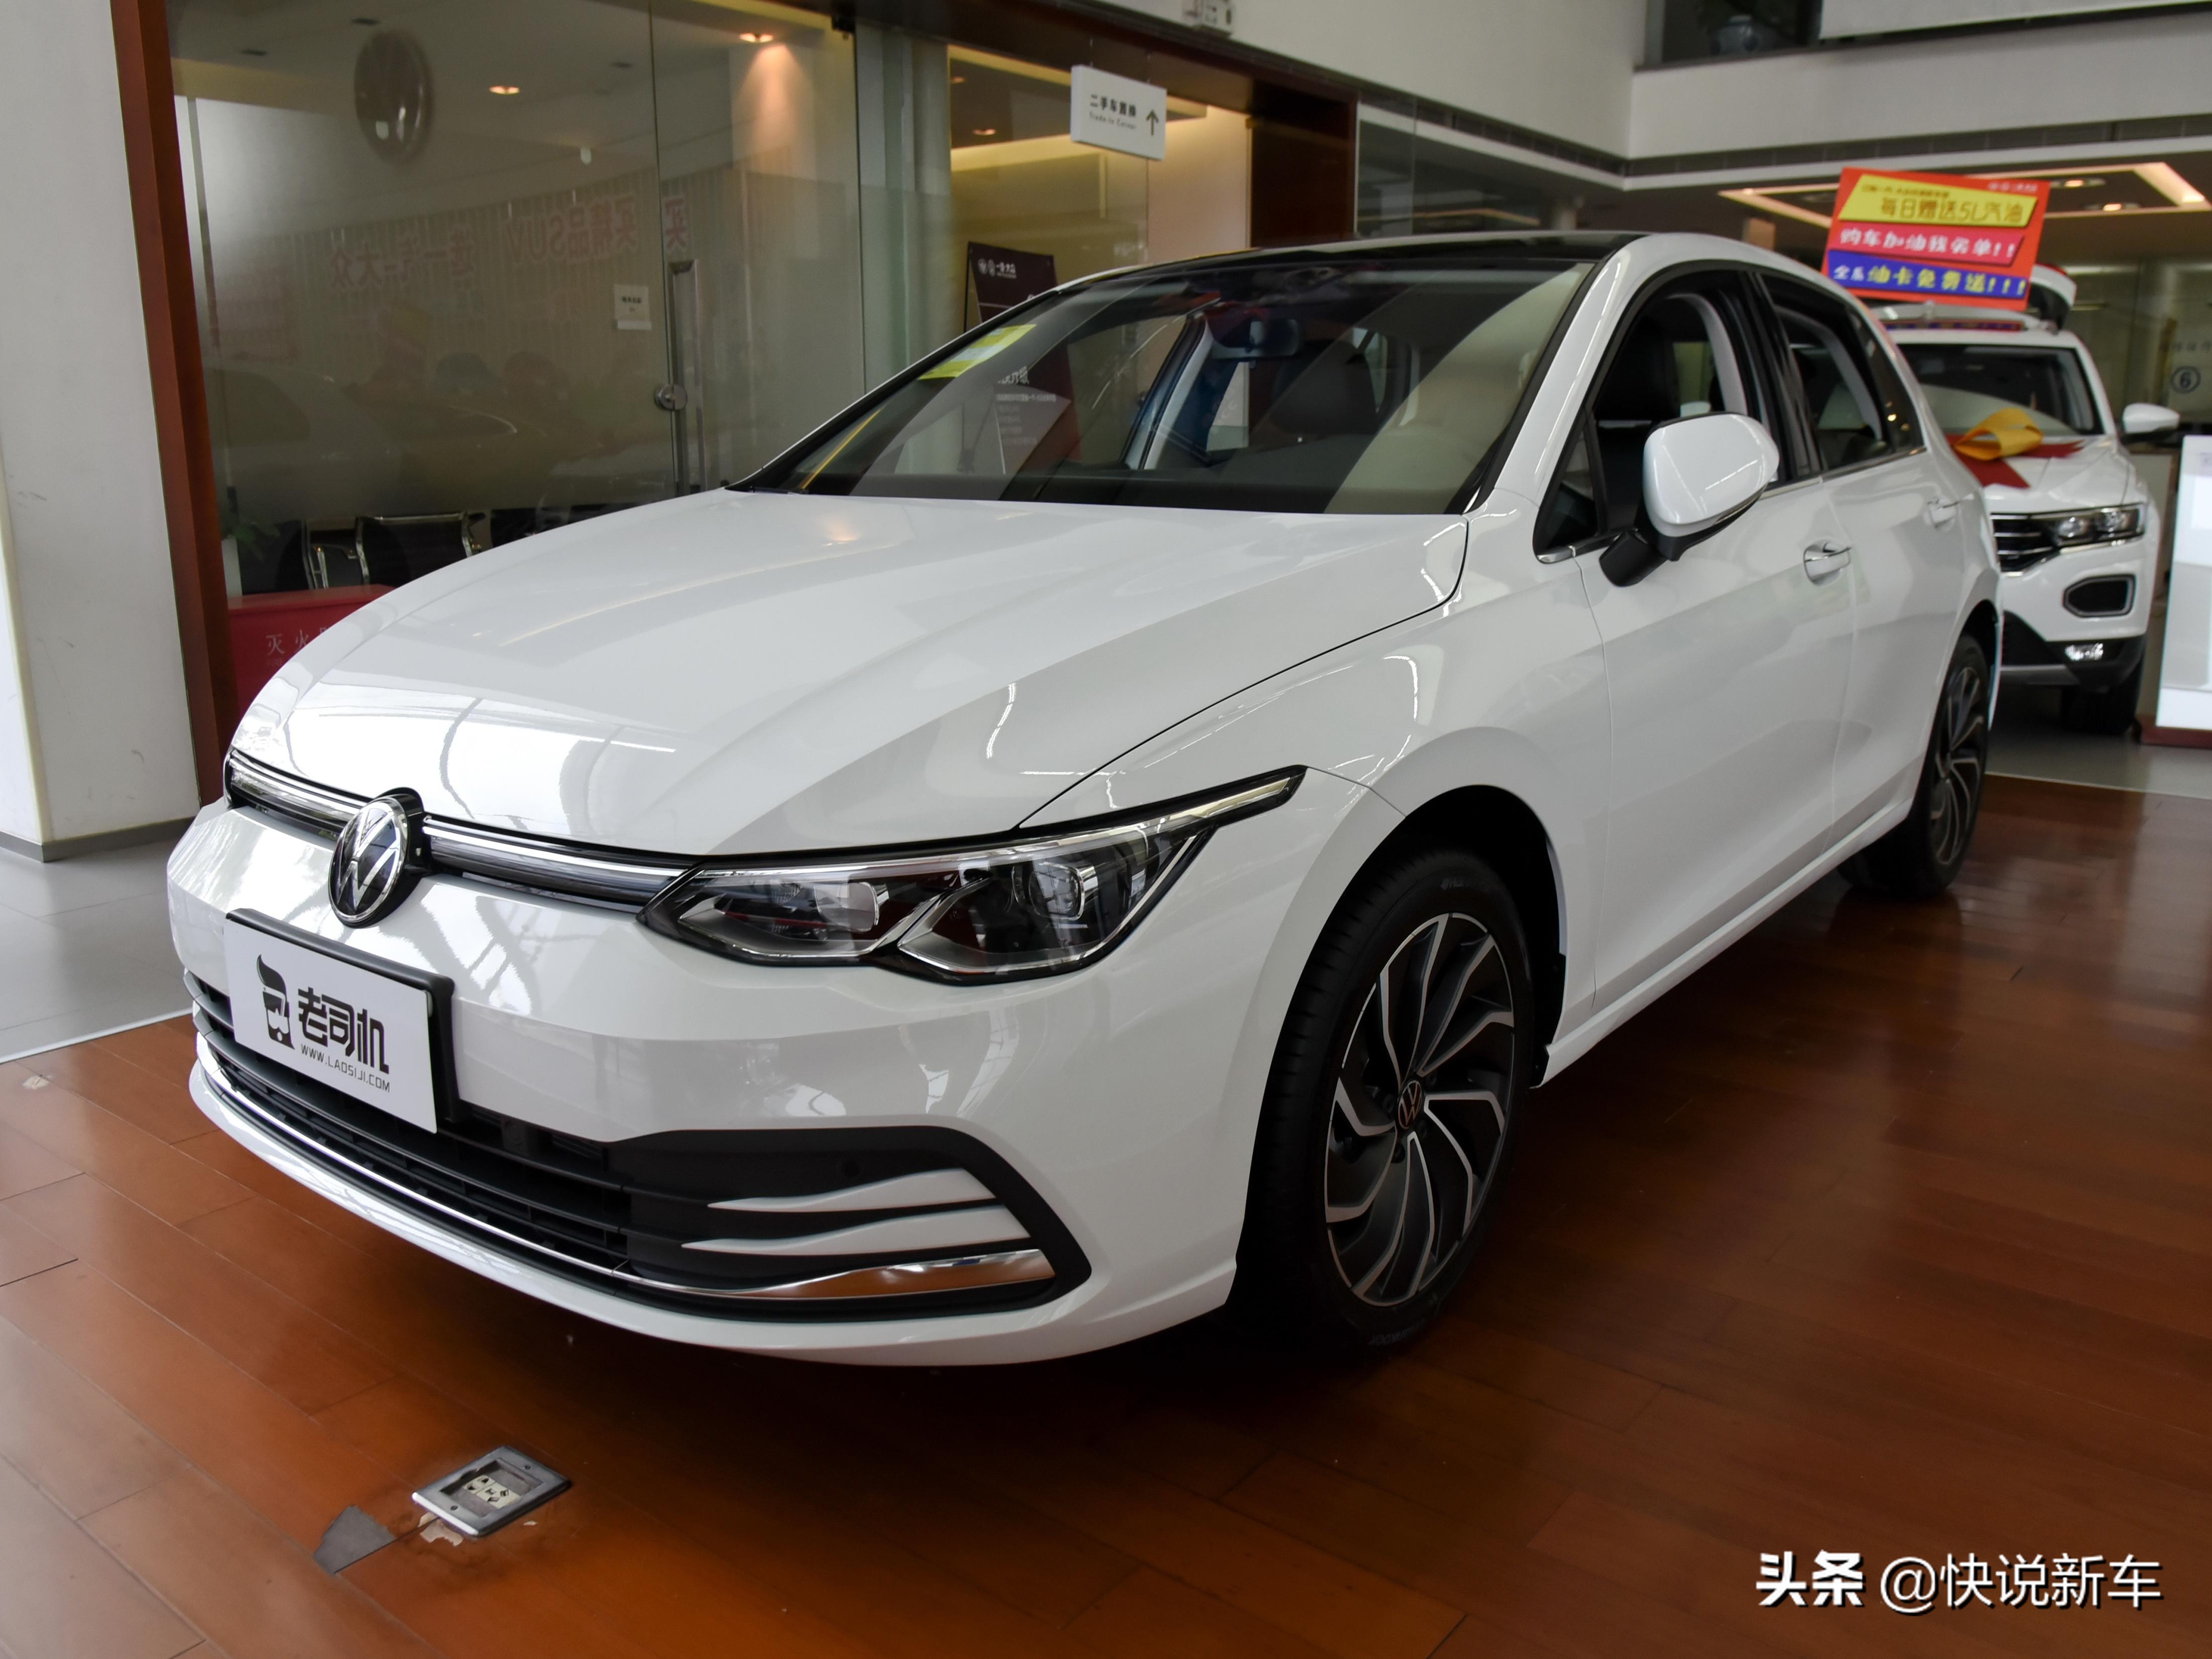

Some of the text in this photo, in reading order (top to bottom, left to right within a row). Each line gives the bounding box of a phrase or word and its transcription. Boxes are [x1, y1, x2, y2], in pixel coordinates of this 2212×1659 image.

[266, 627, 327, 656] 灭火
[298, 986, 389, 1074] 老司机
[301, 1043, 390, 1093] WWW.LAOSIJI.COM
